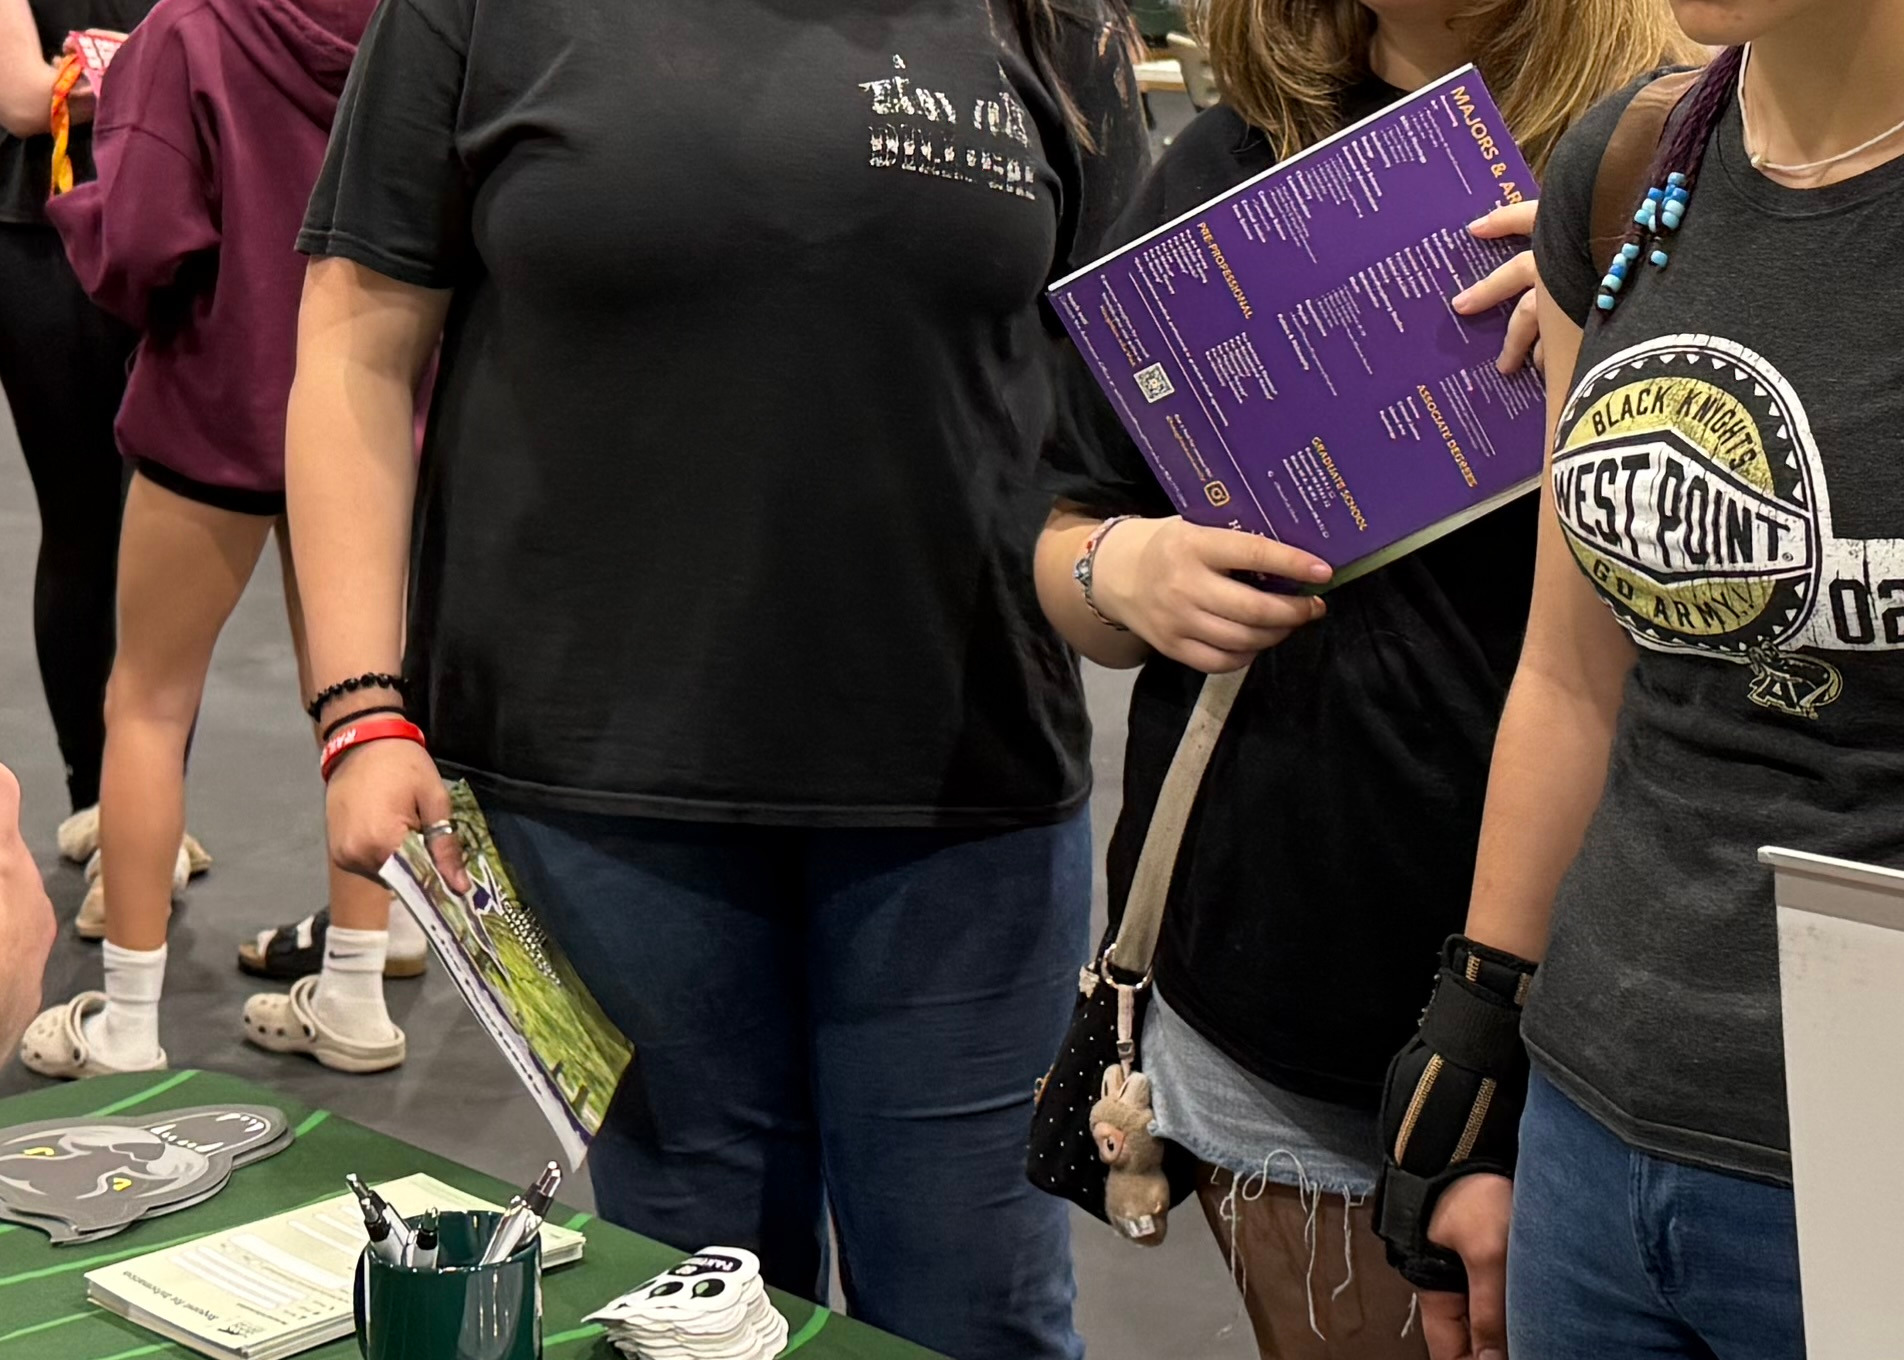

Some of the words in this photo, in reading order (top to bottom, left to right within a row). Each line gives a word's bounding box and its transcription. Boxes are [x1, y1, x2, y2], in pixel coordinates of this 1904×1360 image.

[1449, 84, 1501, 162] MAJORS
[1489, 159, 1509, 178] &
[1498, 176, 1524, 206] AR
[1416, 382, 1453, 440] ASSOCIATE
[1592, 386, 1668, 436] BLACK
[1679, 385, 1756, 470] KNIGHTS
[1310, 434, 1346, 491] GRADUATE
[1553, 453, 1652, 561] WEST
[1656, 454, 1791, 567] POINT
[1593, 559, 1636, 601] GO
